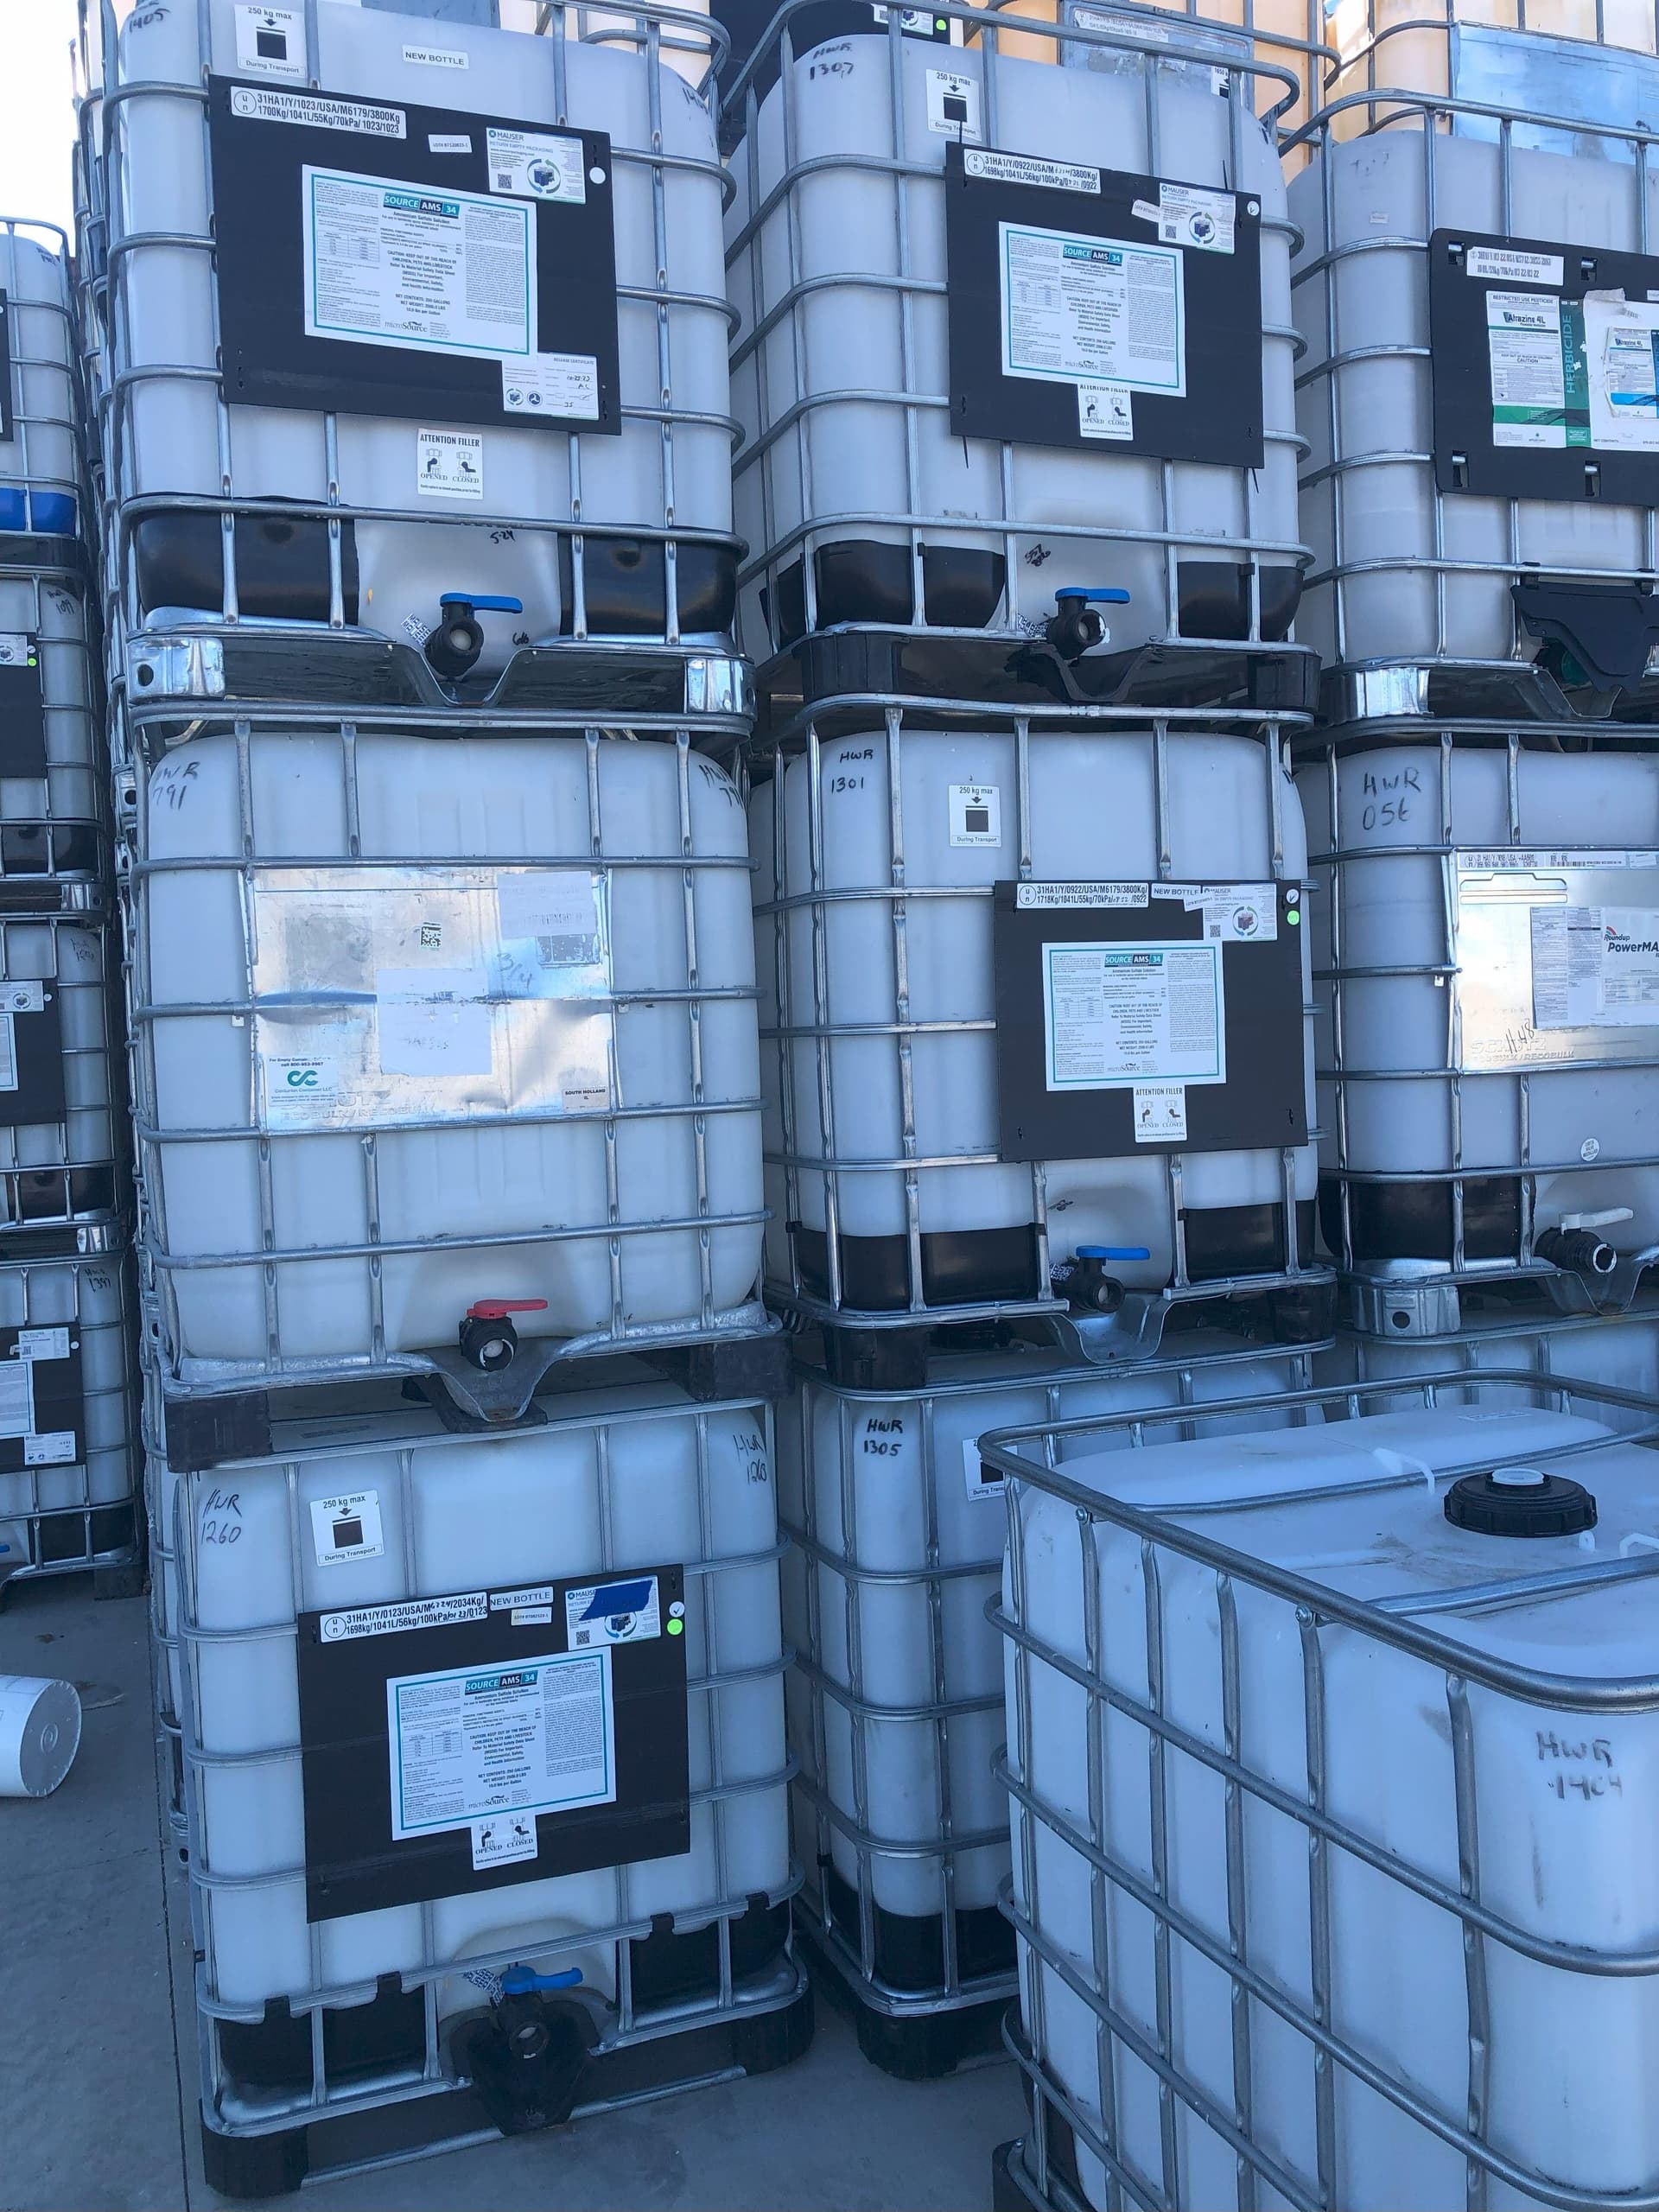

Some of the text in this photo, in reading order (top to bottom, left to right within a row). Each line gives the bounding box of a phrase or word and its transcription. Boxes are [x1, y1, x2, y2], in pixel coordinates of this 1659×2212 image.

[247, 7, 292, 20] 250 kg max
[405, 51, 464, 66] NEW BOTTLE
[245, 60, 300, 73] During Transport
[936, 72, 948, 80] 250
[949, 74, 957, 84] kg
[497, 131, 524, 142] MAUSER
[953, 124, 976, 136] Trnsport
[384, 194, 456, 214] SOURCE AMS 34
[1064, 247, 1090, 257] SOURCE
[1092, 251, 1109, 260] AMS
[1507, 314, 1546, 324] Atrazine 4L
[1563, 314, 1575, 394] HERBICIDE
[420, 434, 480, 448] ATTENTION FILLER
[839, 748, 874, 763] HWR
[831, 777, 864, 794] 1301
[1363, 767, 1421, 798] HWR
[1608, 941, 1659, 953] PowerMA
[1105, 956, 1132, 964] SOURCE
[867, 1419, 903, 1433] HWR
[864, 1440, 902, 1457] 1305
[203, 1489, 242, 1518] HWR
[323, 1500, 336, 1509] 250
[338, 1498, 347, 1507] kg
[200, 1520, 242, 1545] 1260
[325, 1548, 376, 1561] During Transport
[490, 1592, 550, 1606] NEW BOTTLE
[466, 1674, 535, 1691] SOURCE AMS 34
[1536, 1731, 1613, 1768] HWR
[475, 1839, 533, 1854] OPENED CLOSED
